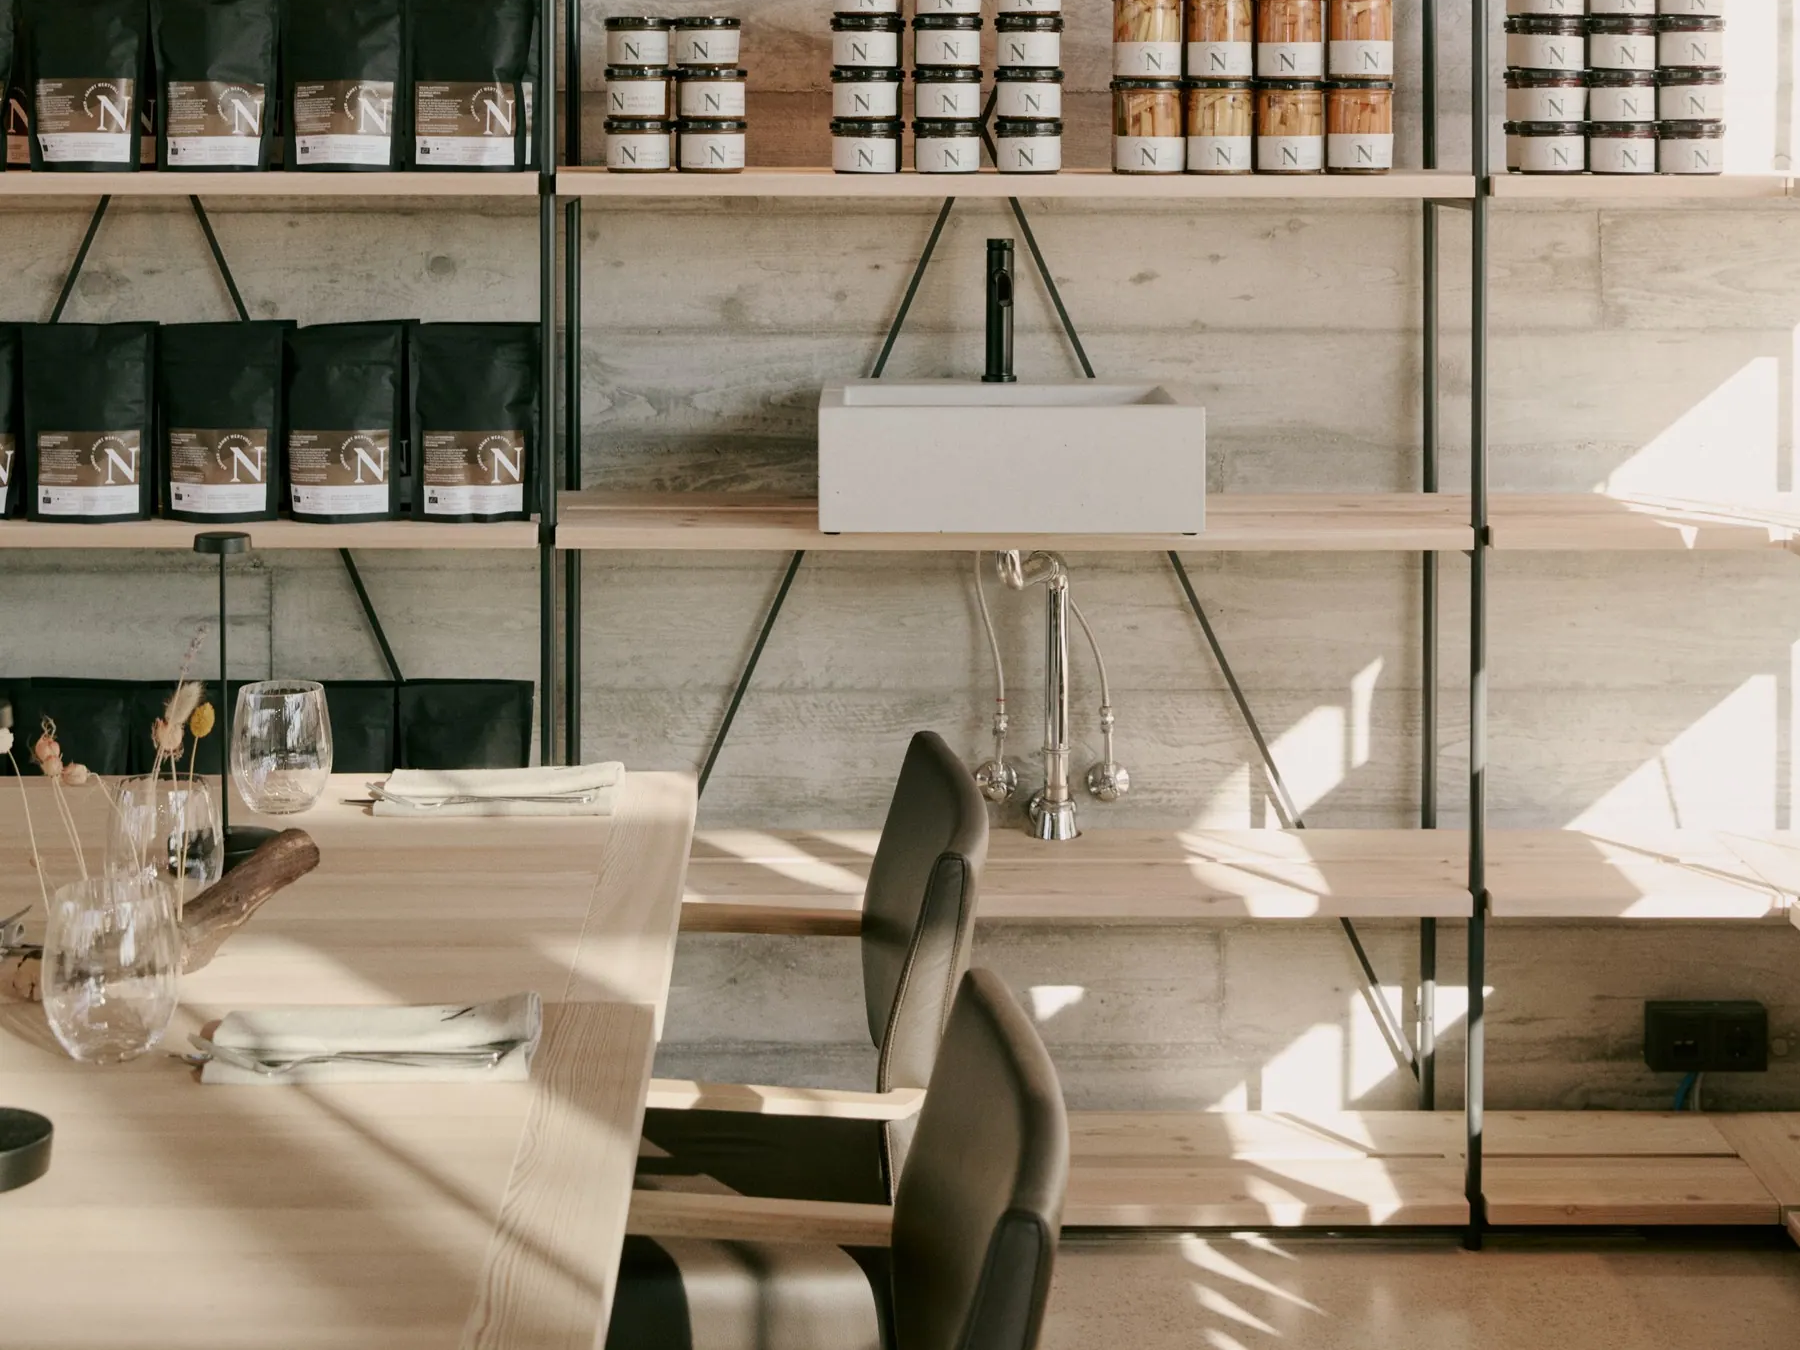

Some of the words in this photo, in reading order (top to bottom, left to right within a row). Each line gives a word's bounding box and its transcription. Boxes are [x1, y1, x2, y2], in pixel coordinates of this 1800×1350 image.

[625, 43, 639, 60] N
[693, 42, 708, 59] N
[852, 43, 868, 61] N
[943, 42, 960, 59] N
[1010, 43, 1026, 61] N
[1549, 46, 1565, 64] N
[1620, 46, 1636, 64] N
[1691, 43, 1707, 61] N
[1146, 52, 1162, 70] N
[1211, 52, 1227, 70] N
[1279, 53, 1295, 71] N
[1364, 51, 1379, 69] N
[612, 93, 624, 110] N
[705, 94, 720, 111] N
[854, 94, 870, 112] N
[942, 94, 958, 112] N
[1024, 94, 1040, 111] N
[1548, 99, 1564, 117] N
[1622, 99, 1638, 117] N
[1690, 97, 1705, 114] N
[96, 95, 132, 131] N
[231, 99, 264, 134] N
[358, 98, 390, 134] N
[483, 100, 514, 135] N
[622, 146, 637, 164] N
[709, 146, 725, 164] N
[858, 149, 874, 167] N
[944, 149, 960, 167] N
[1018, 149, 1034, 166] N
[1141, 148, 1158, 166] N
[1216, 147, 1232, 165] N
[1282, 147, 1298, 165] N
[1356, 145, 1373, 163] N
[1552, 148, 1568, 166] N
[1623, 150, 1638, 167] N
[1694, 150, 1709, 168] N
[104, 447, 139, 484] N
[229, 447, 264, 482] N
[354, 447, 388, 483] N
[491, 447, 523, 483] N
